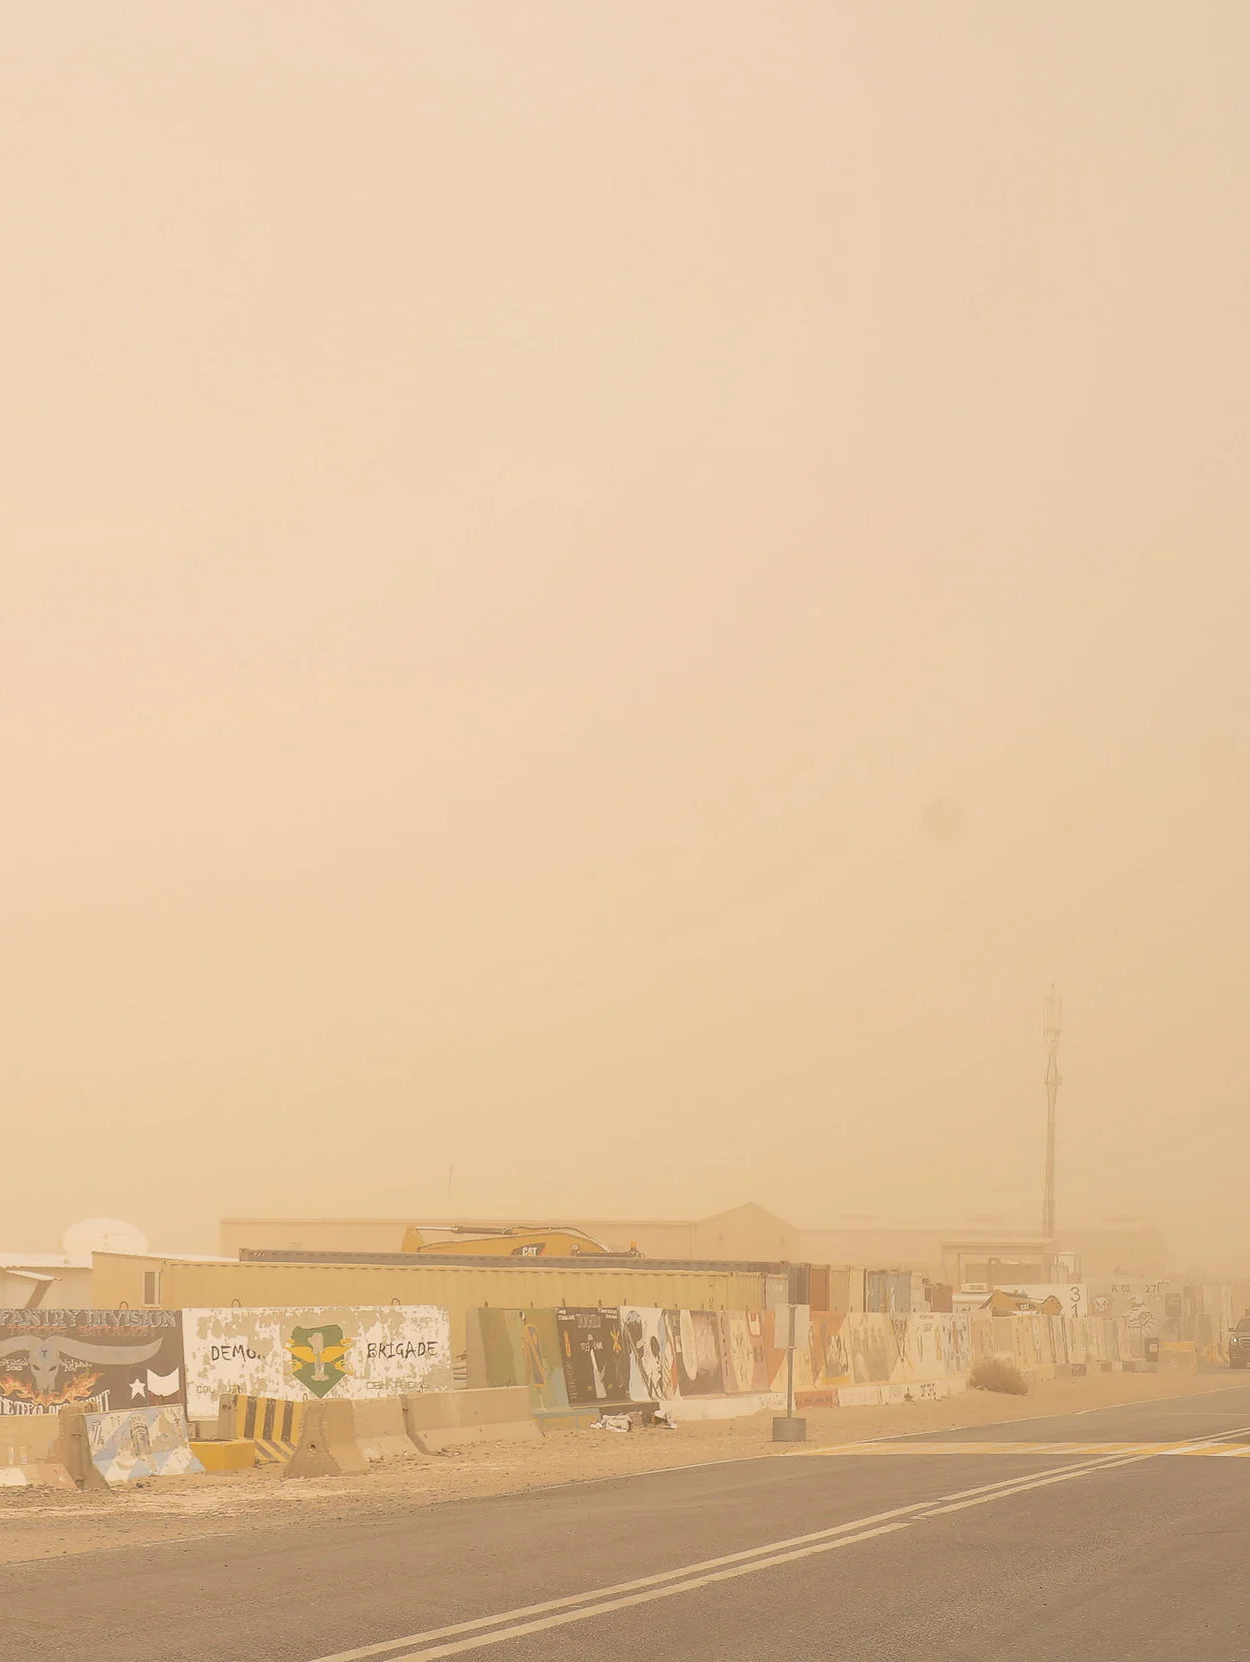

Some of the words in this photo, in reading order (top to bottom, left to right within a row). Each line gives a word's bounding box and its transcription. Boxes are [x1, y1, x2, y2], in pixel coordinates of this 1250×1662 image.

[521, 1246, 538, 1257] CAT
[1070, 1286, 1081, 1303] 3
[85, 1309, 177, 1328] DIVISION
[366, 1341, 438, 1359] BRIGADE
